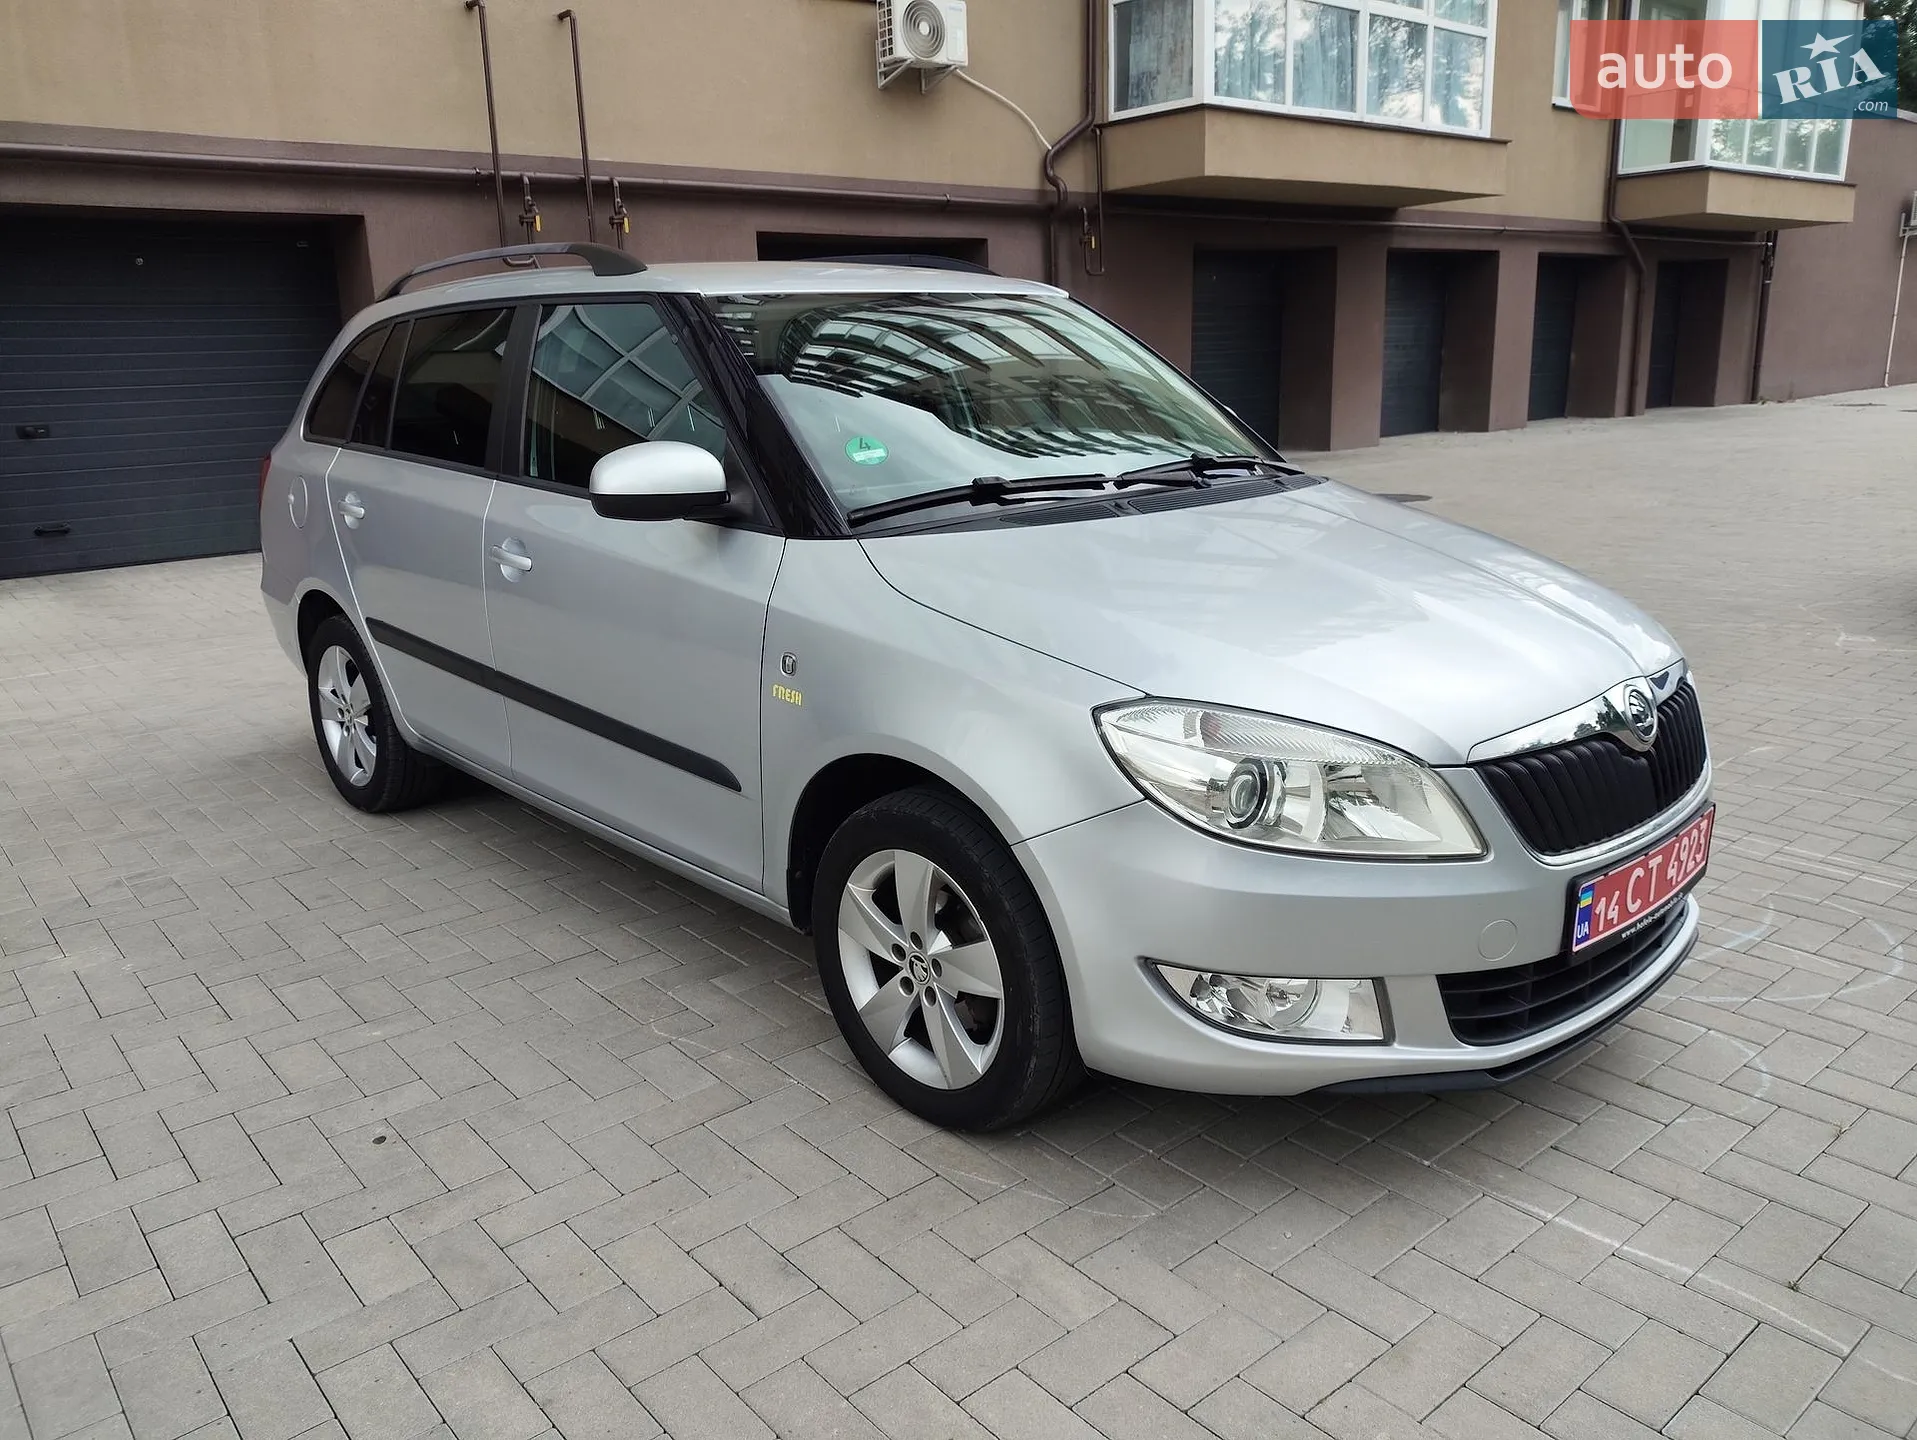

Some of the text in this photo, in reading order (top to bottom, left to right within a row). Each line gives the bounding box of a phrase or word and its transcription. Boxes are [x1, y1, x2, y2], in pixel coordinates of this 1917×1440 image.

[859, 437, 871, 450] 4
[772, 684, 802, 706] FRESH
[1594, 820, 1708, 932] 14 CT 4923
[1577, 921, 1590, 939] UA
